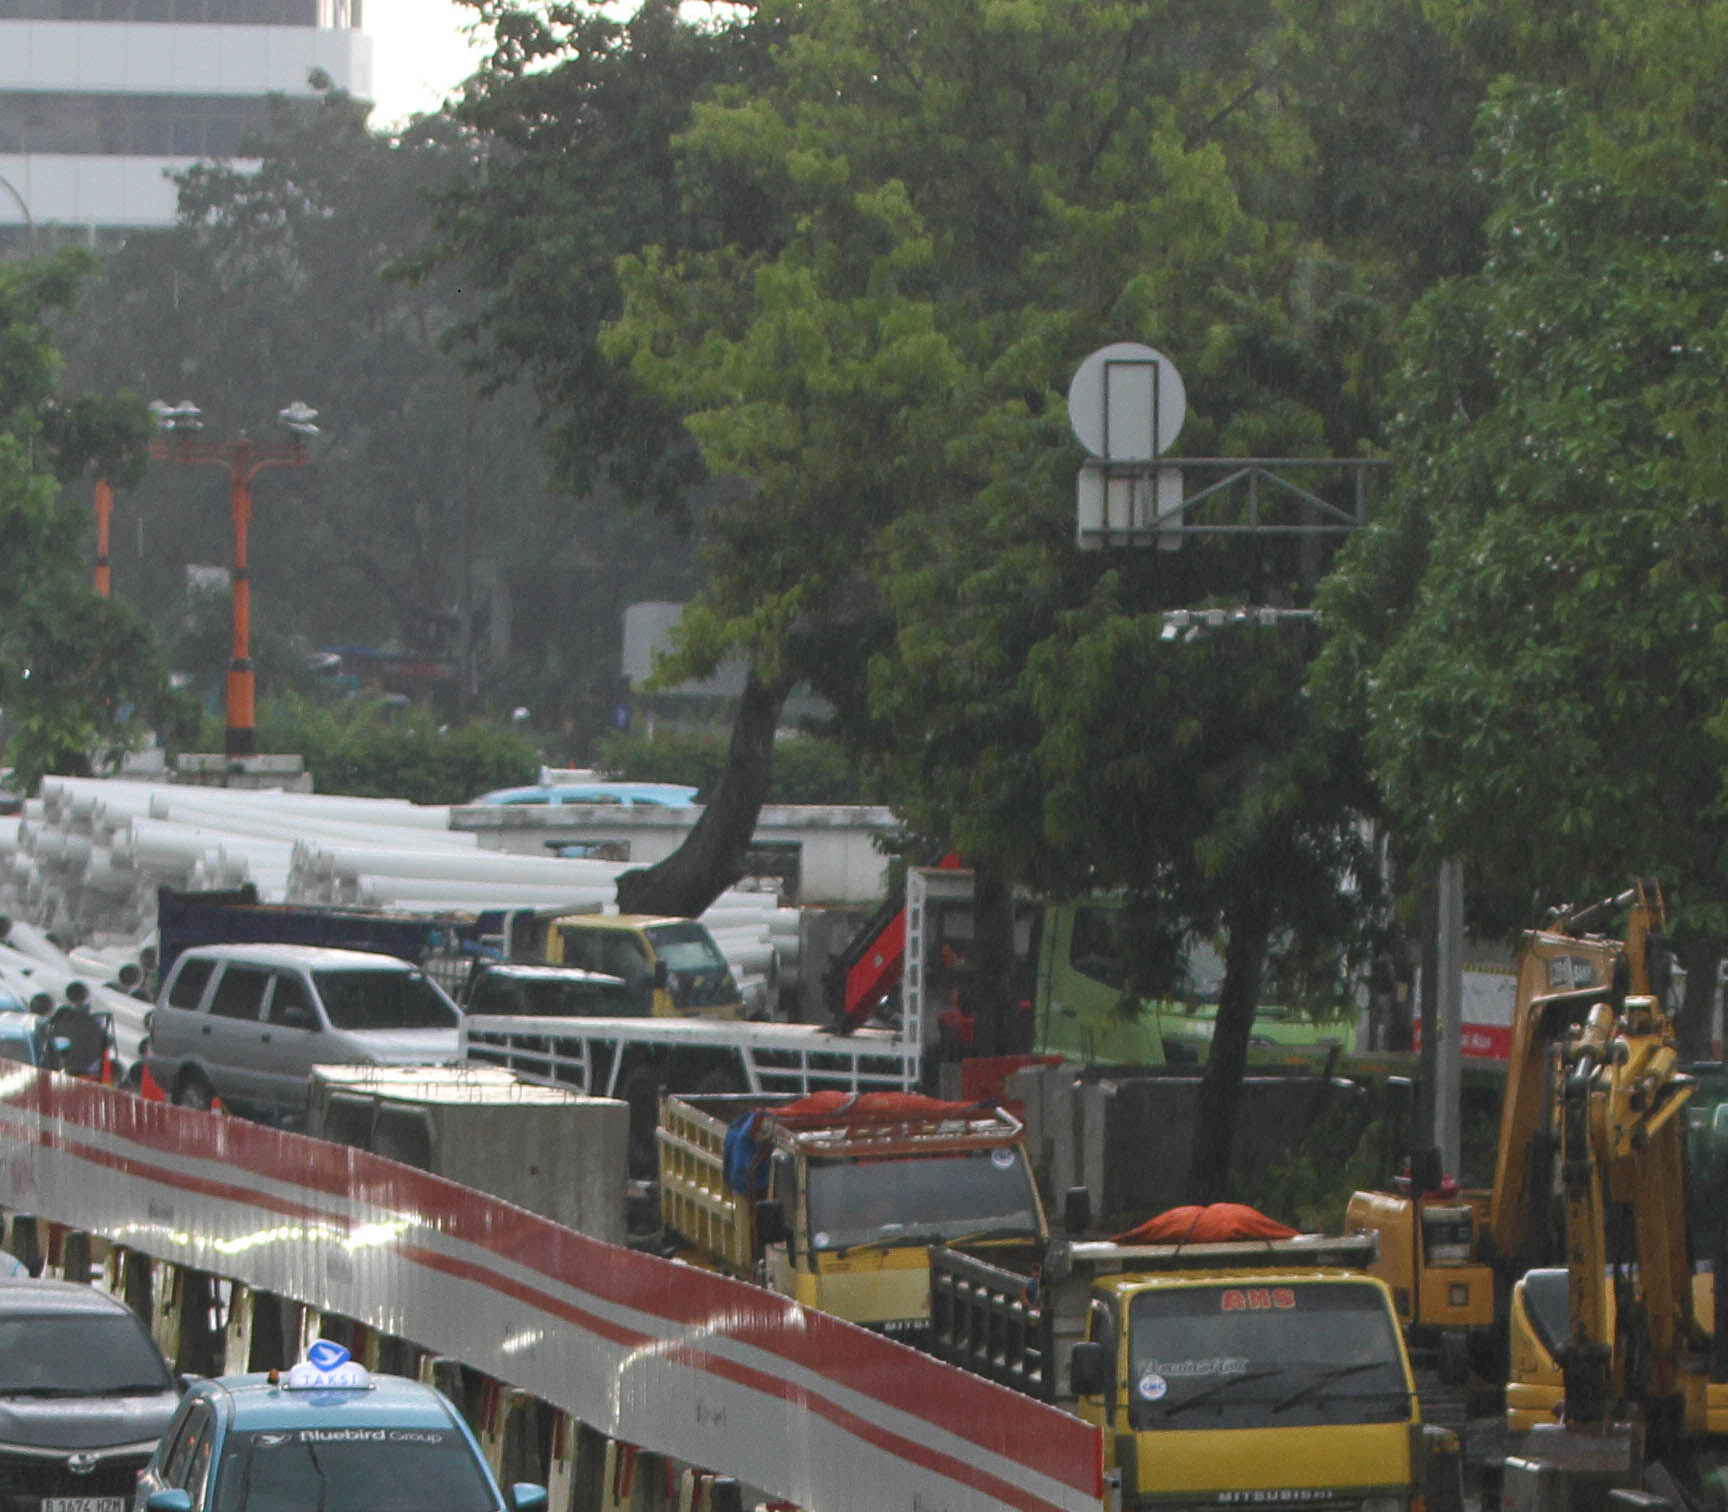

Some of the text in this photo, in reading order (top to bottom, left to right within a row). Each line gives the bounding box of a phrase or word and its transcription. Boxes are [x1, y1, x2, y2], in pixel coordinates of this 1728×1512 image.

[1223, 1288, 1296, 1310] AMS
[303, 1374, 359, 1386] TAKSI
[299, 1429, 442, 1444] Bluebird Group
